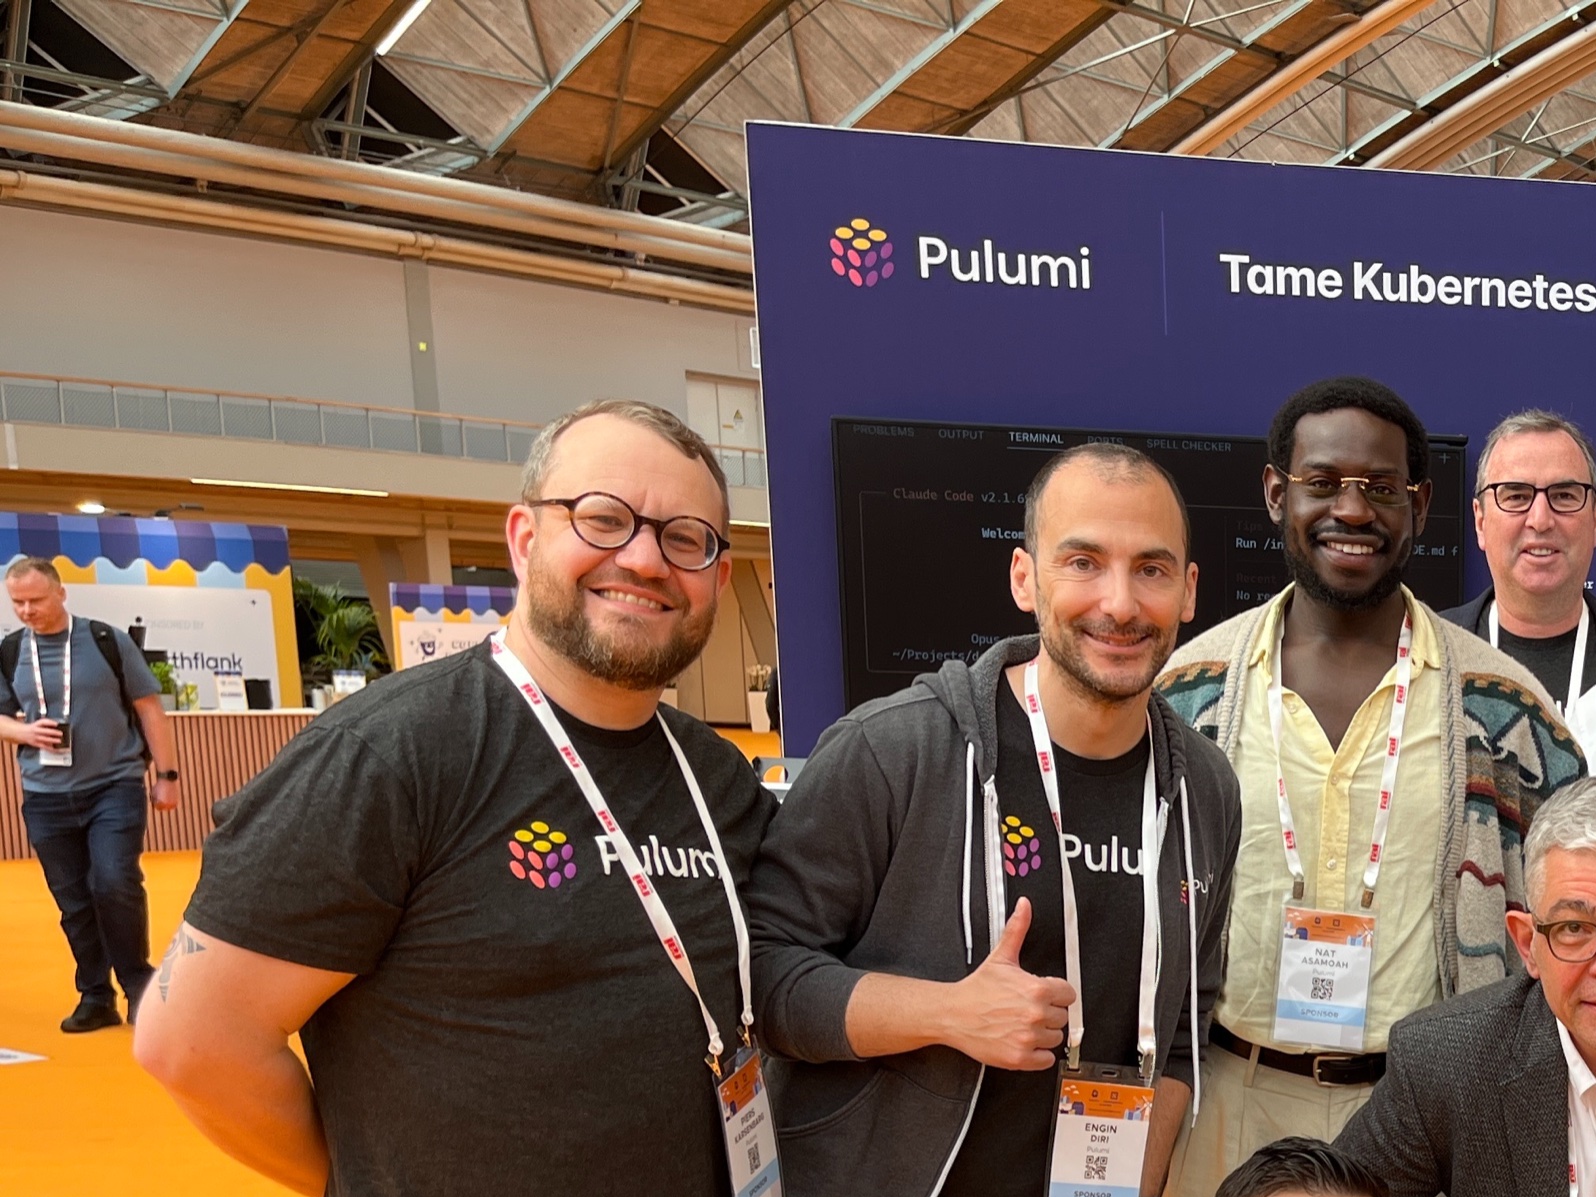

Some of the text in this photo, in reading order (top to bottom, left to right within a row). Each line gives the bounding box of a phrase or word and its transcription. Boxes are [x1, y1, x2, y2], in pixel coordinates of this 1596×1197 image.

[917, 235, 1092, 290] Pulumi
[1219, 253, 1343, 299] Tame
[1353, 261, 1596, 313] Kubernetes
[853, 425, 915, 438] PROBLEMS
[938, 429, 985, 440] OUTPUT
[1008, 432, 1064, 444] TERMINAL
[1087, 435, 1124, 446] PORTS
[1146, 438, 1232, 452] SPELL CHECKER
[893, 488, 1026, 504] Claude Code v2.1.6
[981, 527, 1026, 540] Welcom
[1235, 537, 1257, 549] Run
[1263, 537, 1285, 550] /in
[1236, 590, 1251, 601] No
[970, 633, 1000, 646] Opus
[168, 651, 243, 671] thflank
[1315, 948, 1337, 958] NAT
[1301, 957, 1349, 969] ASAMOAH
[1300, 1008, 1339, 1019] SPONSOR
[1085, 1122, 1117, 1134] ENGIN
[1090, 1134, 1109, 1144] DIRI
[749, 1176, 768, 1197] SPONSOR
